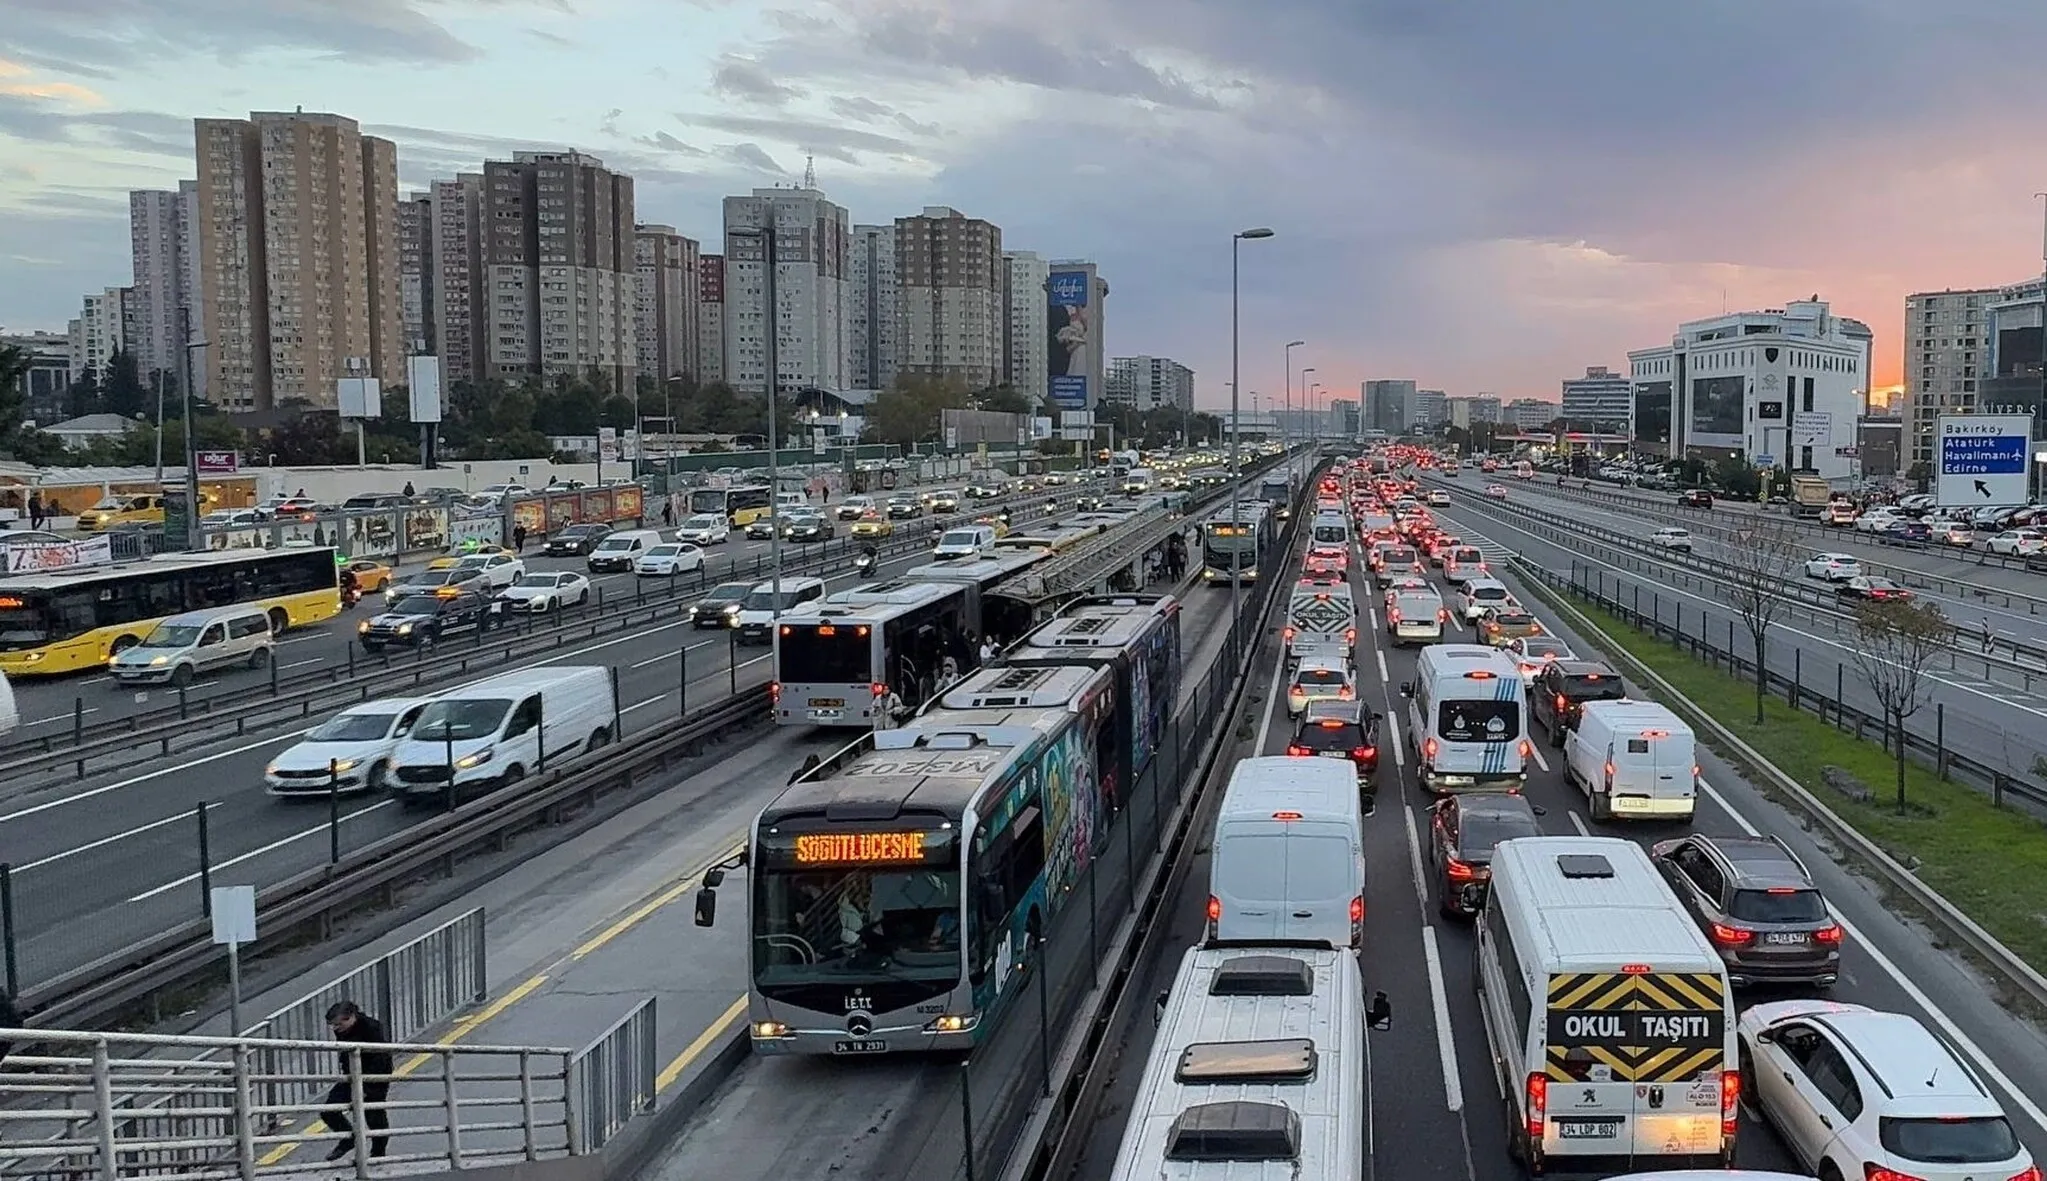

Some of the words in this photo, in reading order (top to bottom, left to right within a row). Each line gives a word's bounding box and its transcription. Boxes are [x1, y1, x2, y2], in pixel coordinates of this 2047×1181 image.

[1946, 424, 2003, 435] Bakırköy
[1945, 438, 1995, 448] Atatürk
[1945, 451, 2010, 460] Havalimanı
[1944, 463, 1988, 473] Edirne
[1565, 1016, 1626, 1037] OKUL
[1641, 1016, 1709, 1042] TAŞITI
[1565, 1125, 1576, 1135] 34
